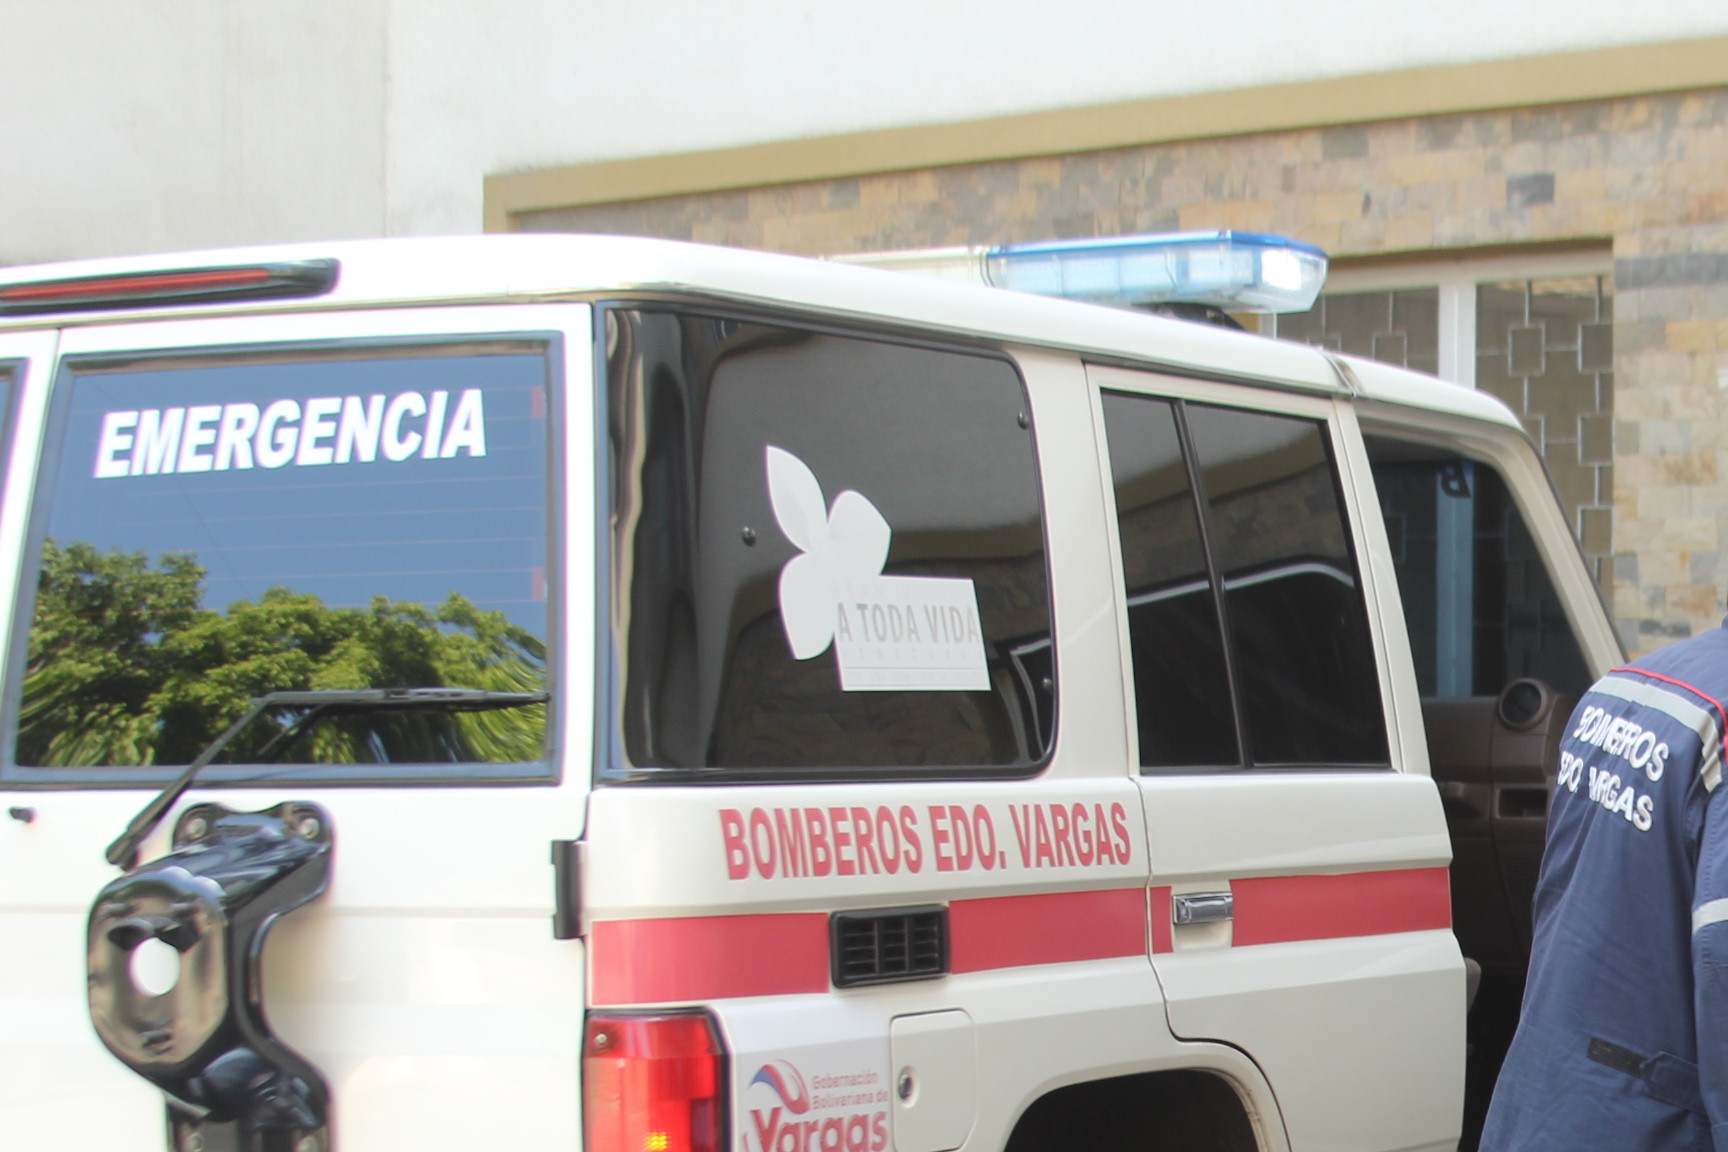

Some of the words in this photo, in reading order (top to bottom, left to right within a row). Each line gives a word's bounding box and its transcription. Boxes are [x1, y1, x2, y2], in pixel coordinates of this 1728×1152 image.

[93, 388, 487, 478] EMERGENCIA
[837, 602, 852, 643] A
[856, 602, 921, 645] TODA
[924, 604, 981, 646] VIDA
[718, 804, 923, 880] BOMBEROS
[928, 803, 1007, 873] EDO.
[1008, 801, 1131, 869] VARGAS
[812, 1069, 880, 1090] Gobernación
[813, 1091, 874, 1110] Bolivariana
[876, 1088, 889, 1103] de
